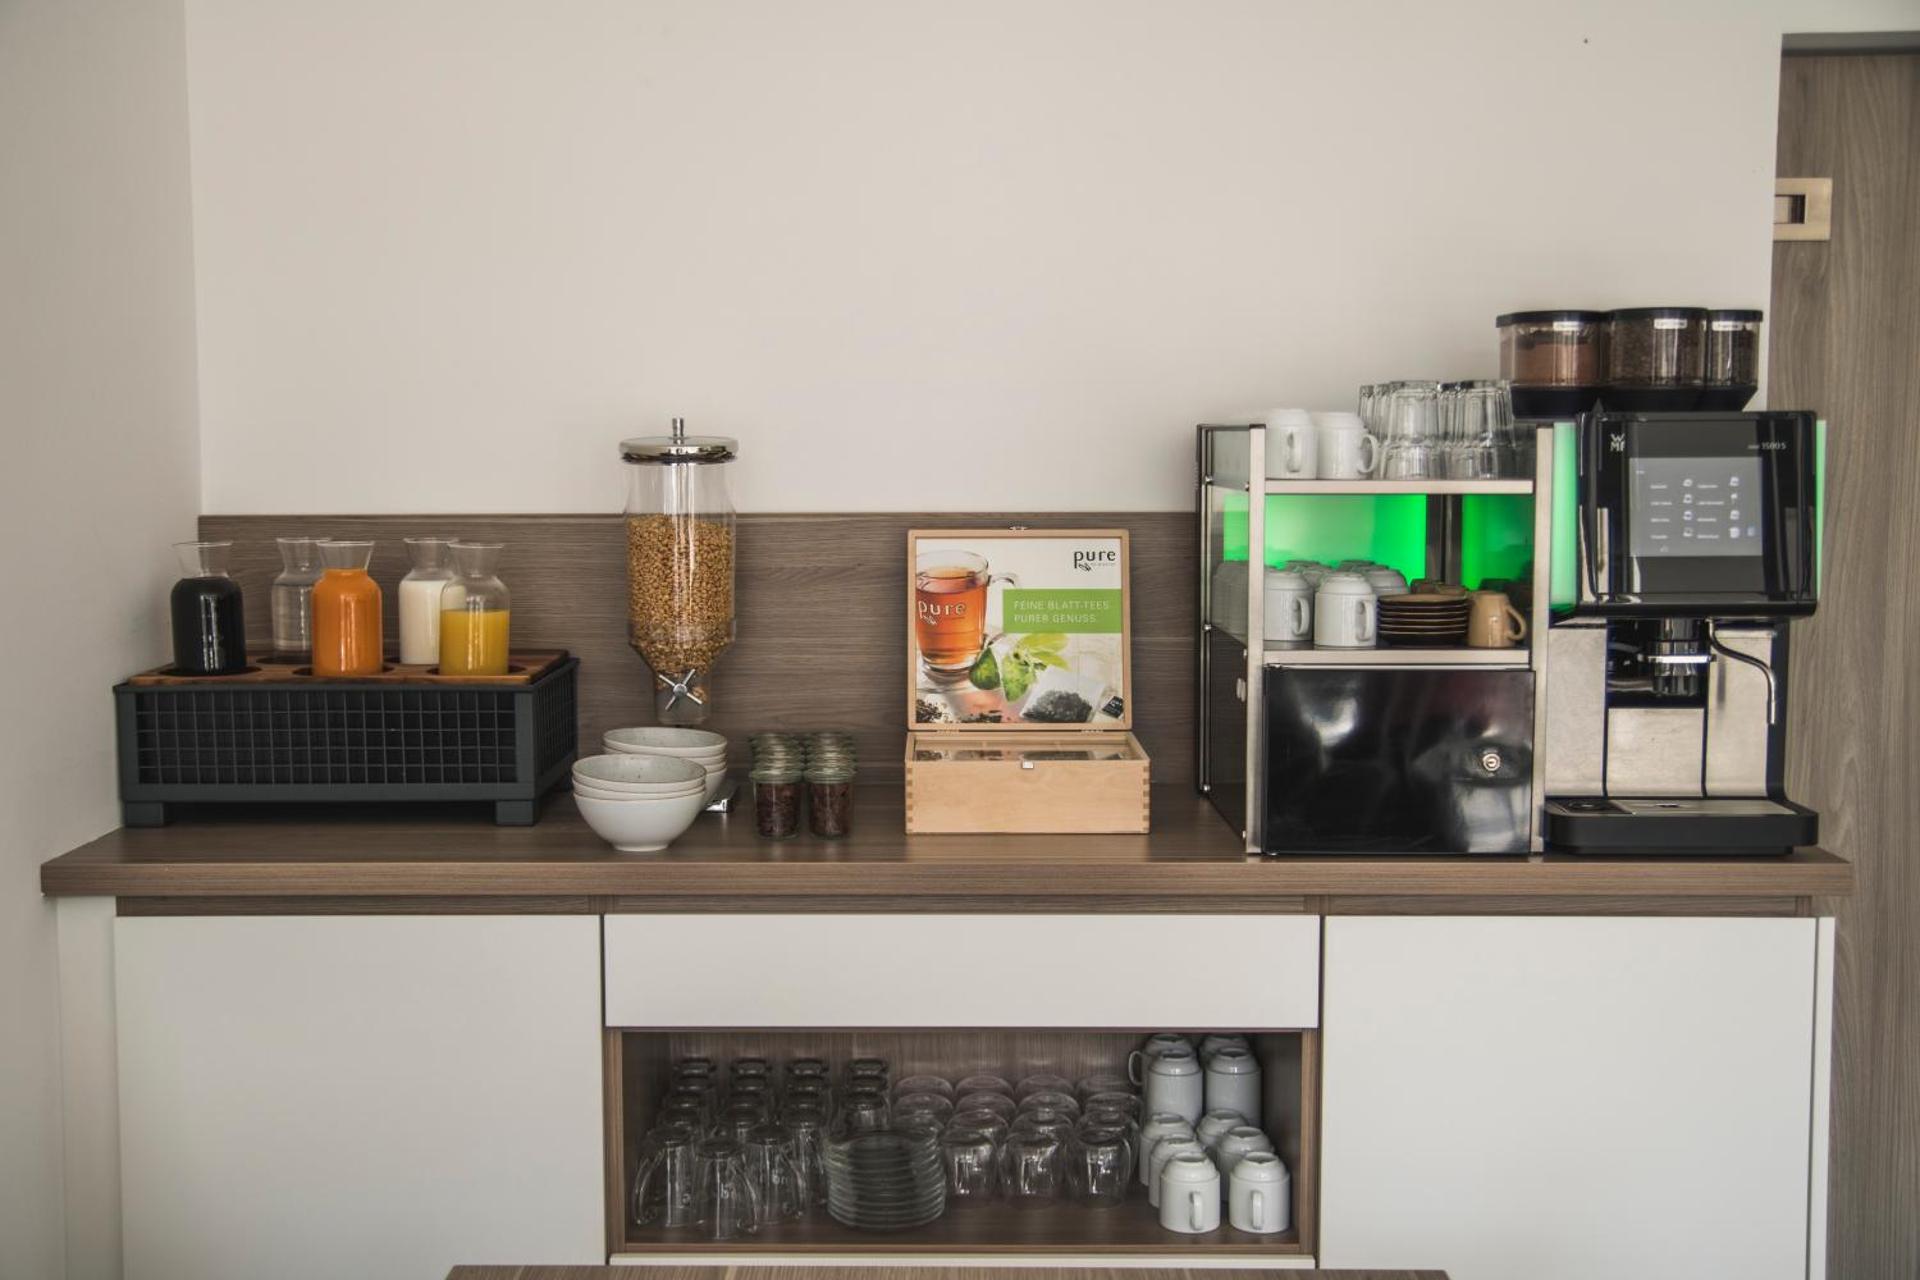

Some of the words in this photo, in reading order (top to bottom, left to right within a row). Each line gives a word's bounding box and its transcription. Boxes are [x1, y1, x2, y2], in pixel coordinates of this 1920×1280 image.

[1073, 551, 1116, 569] pure
[918, 600, 966, 619] pure
[1014, 600, 1045, 610] FEINE
[1014, 614, 1049, 624] PURER
[1052, 614, 1097, 624] GENUSS
